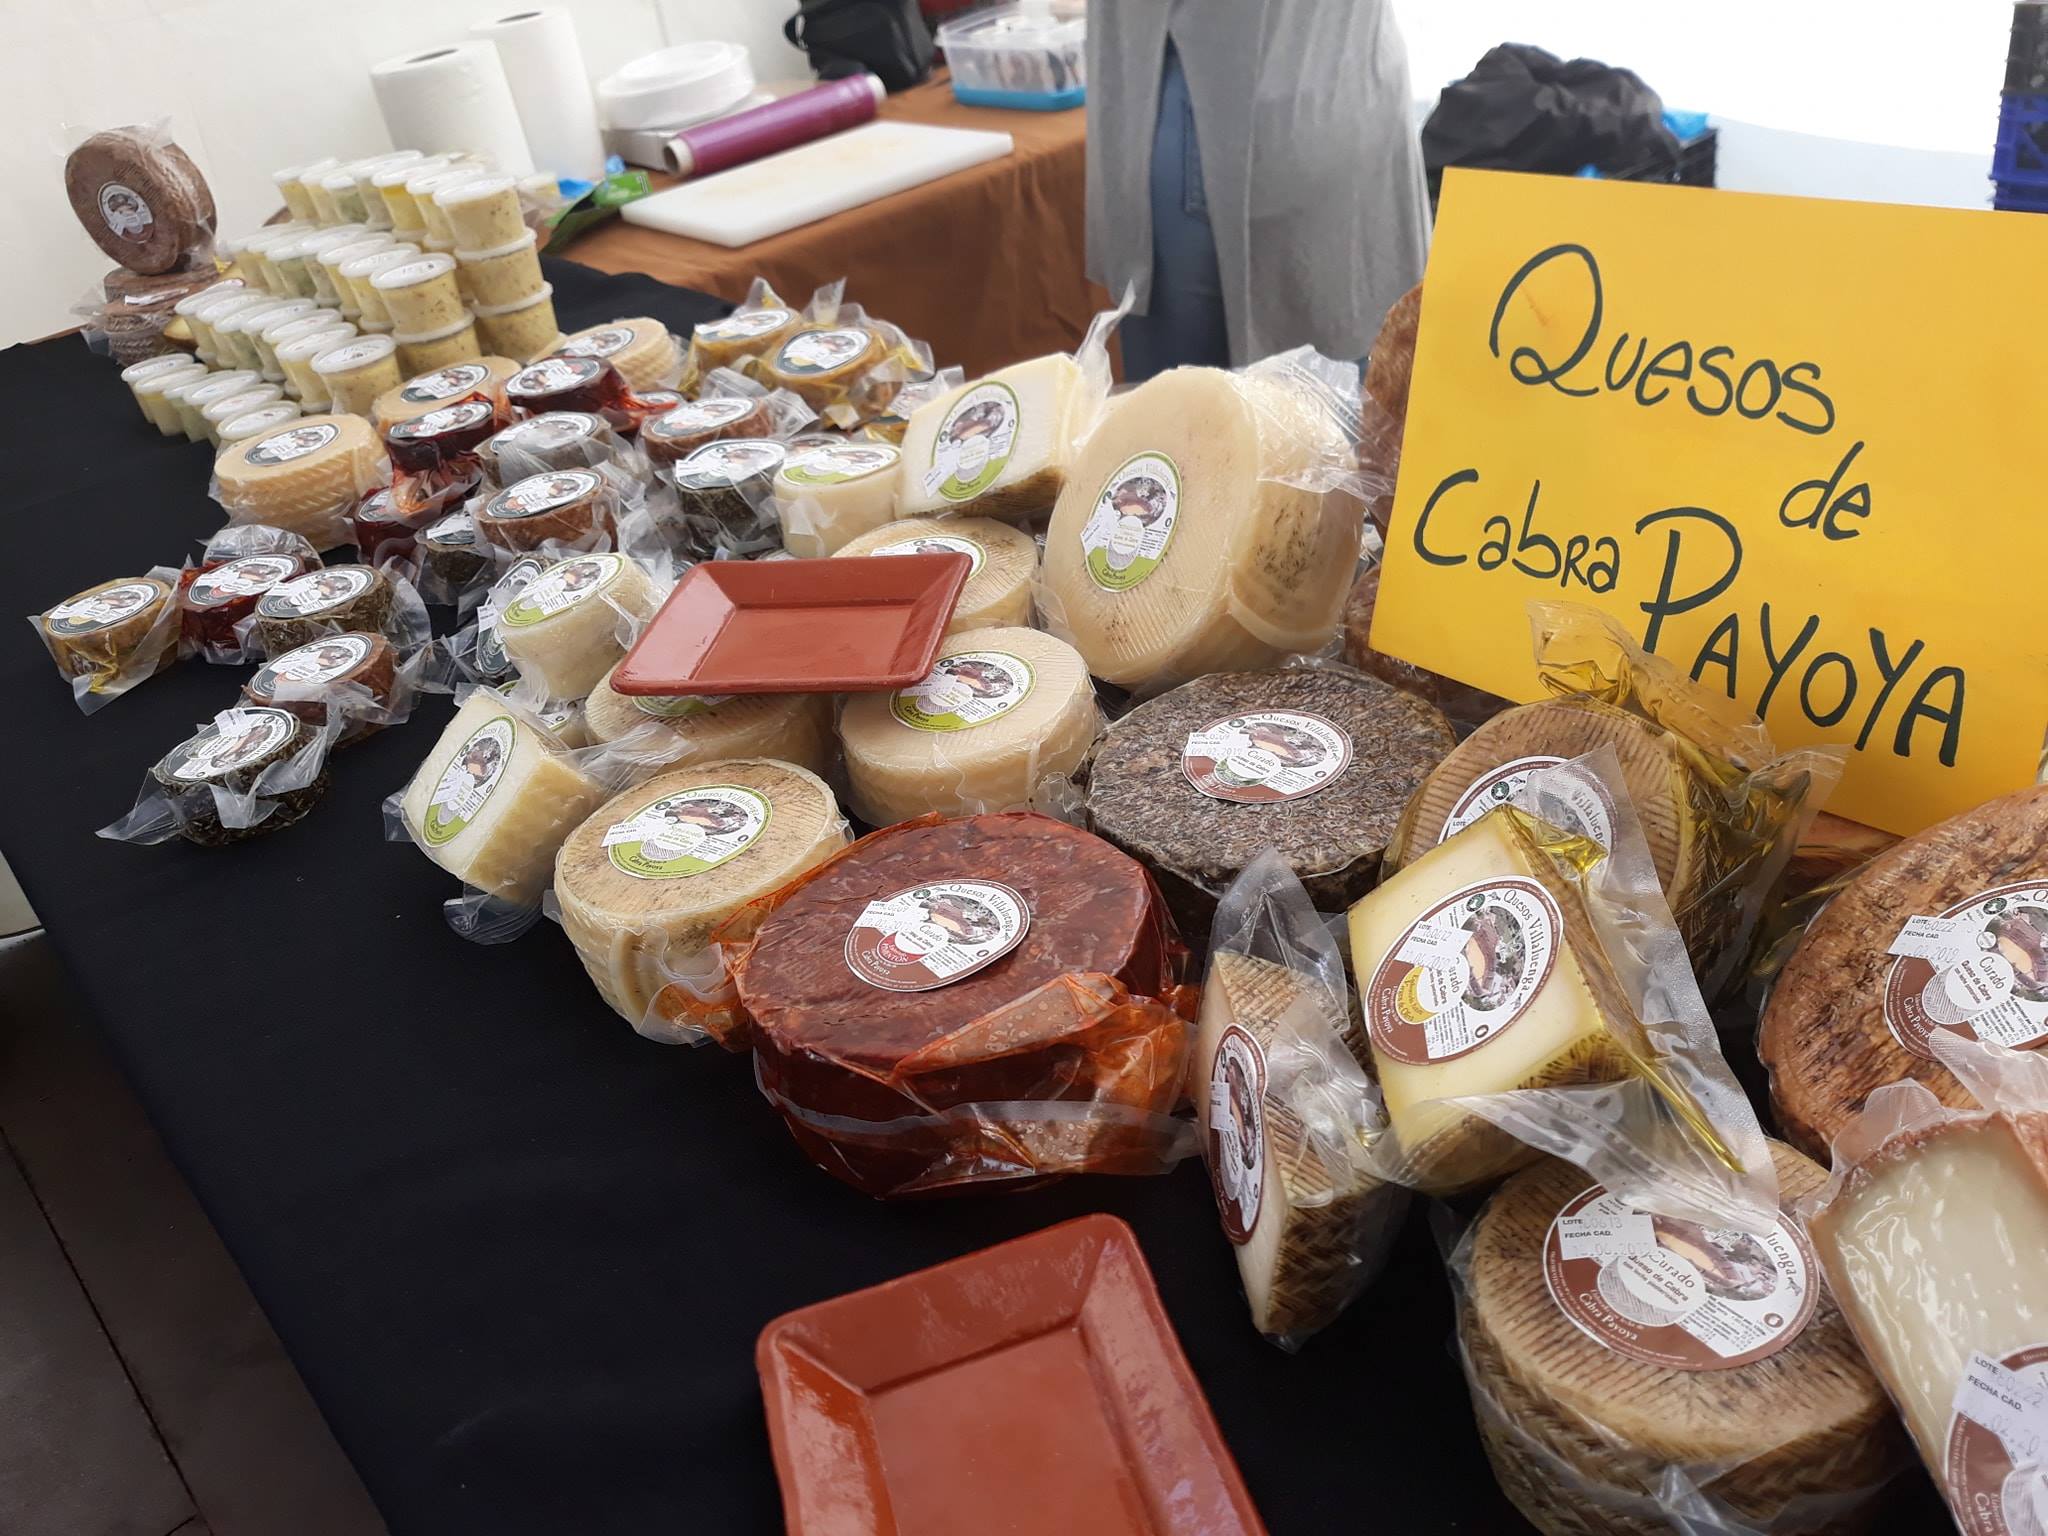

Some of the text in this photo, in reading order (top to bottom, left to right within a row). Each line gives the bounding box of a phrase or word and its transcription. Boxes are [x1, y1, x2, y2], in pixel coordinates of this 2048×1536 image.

[1489, 243, 1836, 435] Quesos
[1779, 441, 1872, 541] de
[1413, 468, 1966, 767] Cabra PAYOYA
[1262, 713, 1301, 726] Quesos
[1247, 750, 1275, 768] Curado
[950, 884, 987, 899] Quesos
[1504, 889, 1545, 991] Quesos Villaluenga
[1903, 930, 1925, 939] FECHA
[1961, 959, 1976, 979] Queso
[1978, 983, 1992, 1001] Cabra
[1979, 956, 2006, 990] Curado
[1904, 996, 1915, 1019] Cabra
[1564, 1230, 1591, 1239] FECHA
[1765, 1231, 1797, 1275] luenga
[1648, 1249, 1696, 1289] Curado
[1653, 1272, 1664, 1283] de
[1664, 1281, 1689, 1301] Cabra
[1579, 1292, 1638, 1341] Cabra Payoya
[1975, 1356, 2000, 1374] LOTE
[1967, 1374, 2023, 1412] FECHA CAD.
[1975, 1492, 1994, 1533] Cabra
